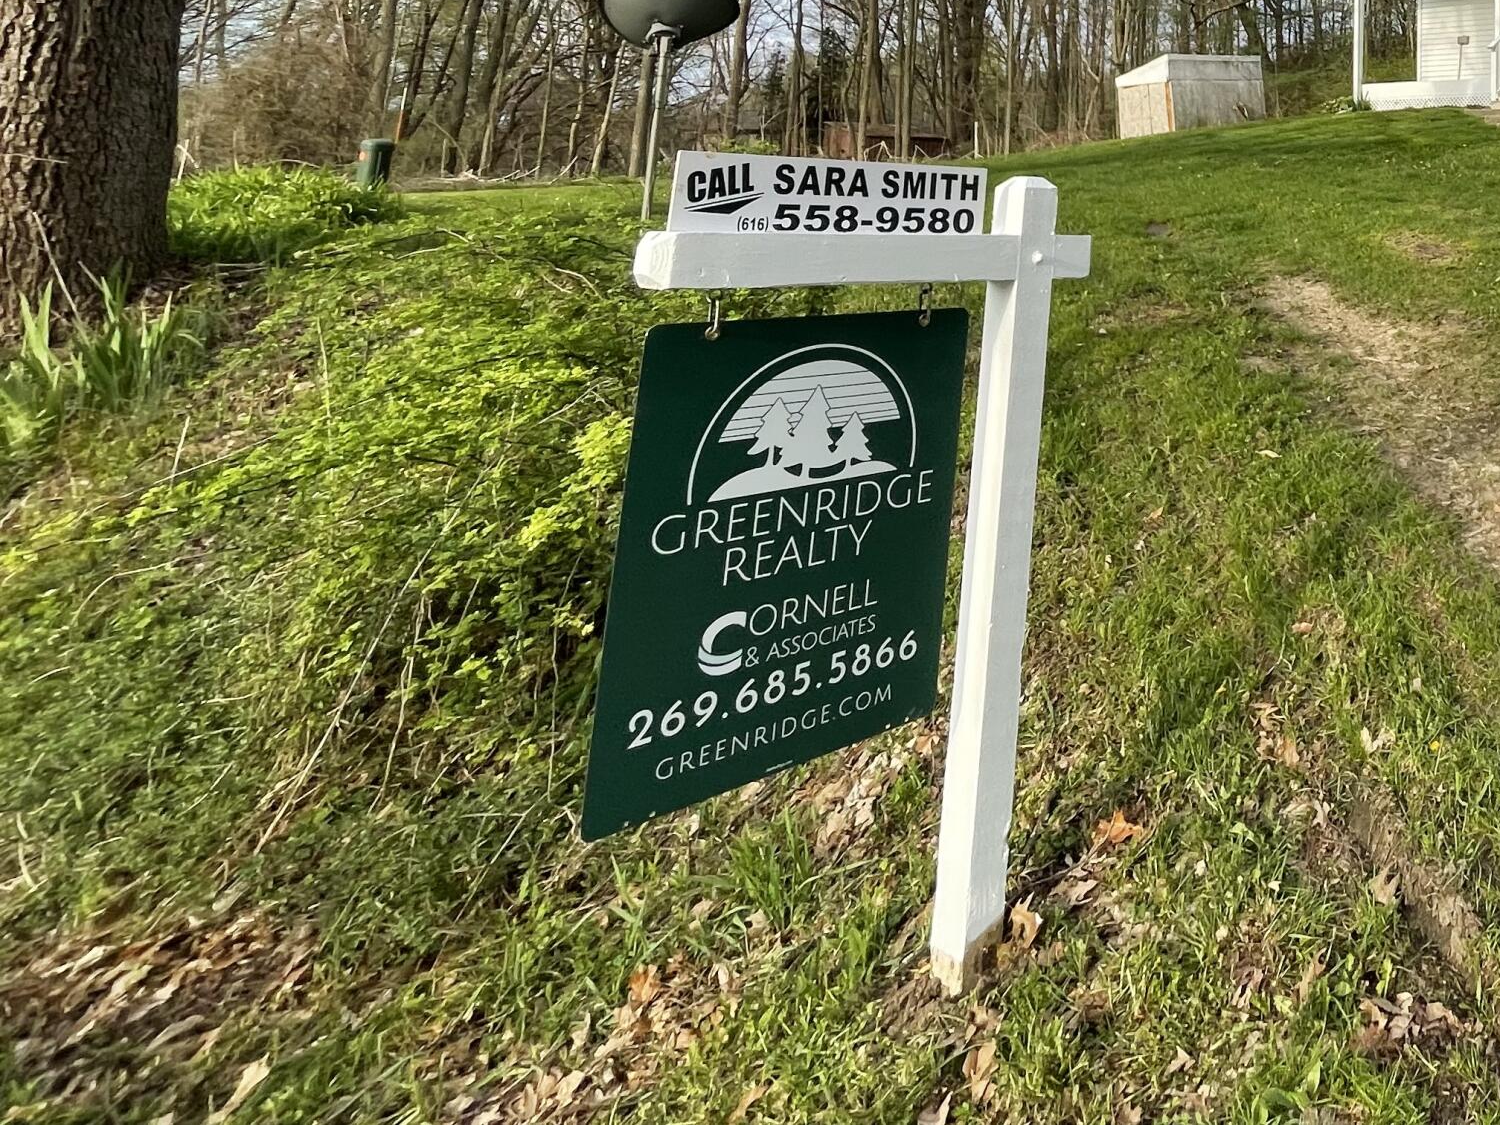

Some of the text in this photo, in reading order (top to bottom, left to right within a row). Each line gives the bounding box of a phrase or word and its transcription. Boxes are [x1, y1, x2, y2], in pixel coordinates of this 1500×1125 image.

[686, 163, 979, 203] CALL SARA SMITH
[737, 204, 975, 233] (616) 558-9580
[651, 470, 933, 555] GREENRIDGE
[722, 519, 873, 586] REALTY
[698, 578, 878, 677] CORNELL
[744, 613, 876, 668] & ASSOCIATES
[627, 629, 918, 750] 269.685.5866
[655, 683, 892, 781] GREENRIDGE.COM
